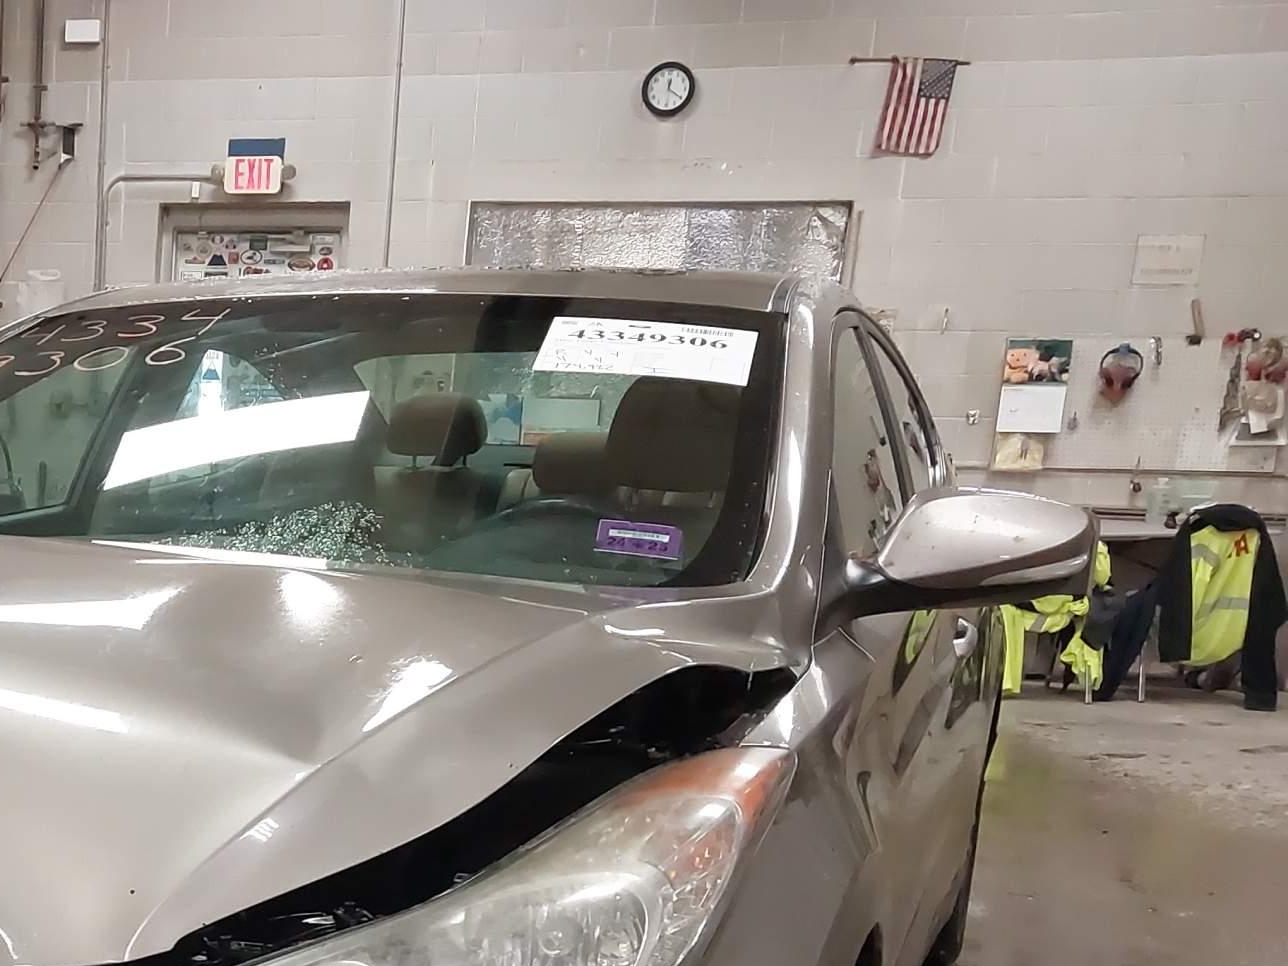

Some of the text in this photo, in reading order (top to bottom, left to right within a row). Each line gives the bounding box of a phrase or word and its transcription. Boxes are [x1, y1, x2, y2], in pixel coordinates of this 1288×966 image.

[234, 158, 274, 190] EXIT
[20, 307, 232, 347] 4334
[567, 328, 729, 350] 43349306
